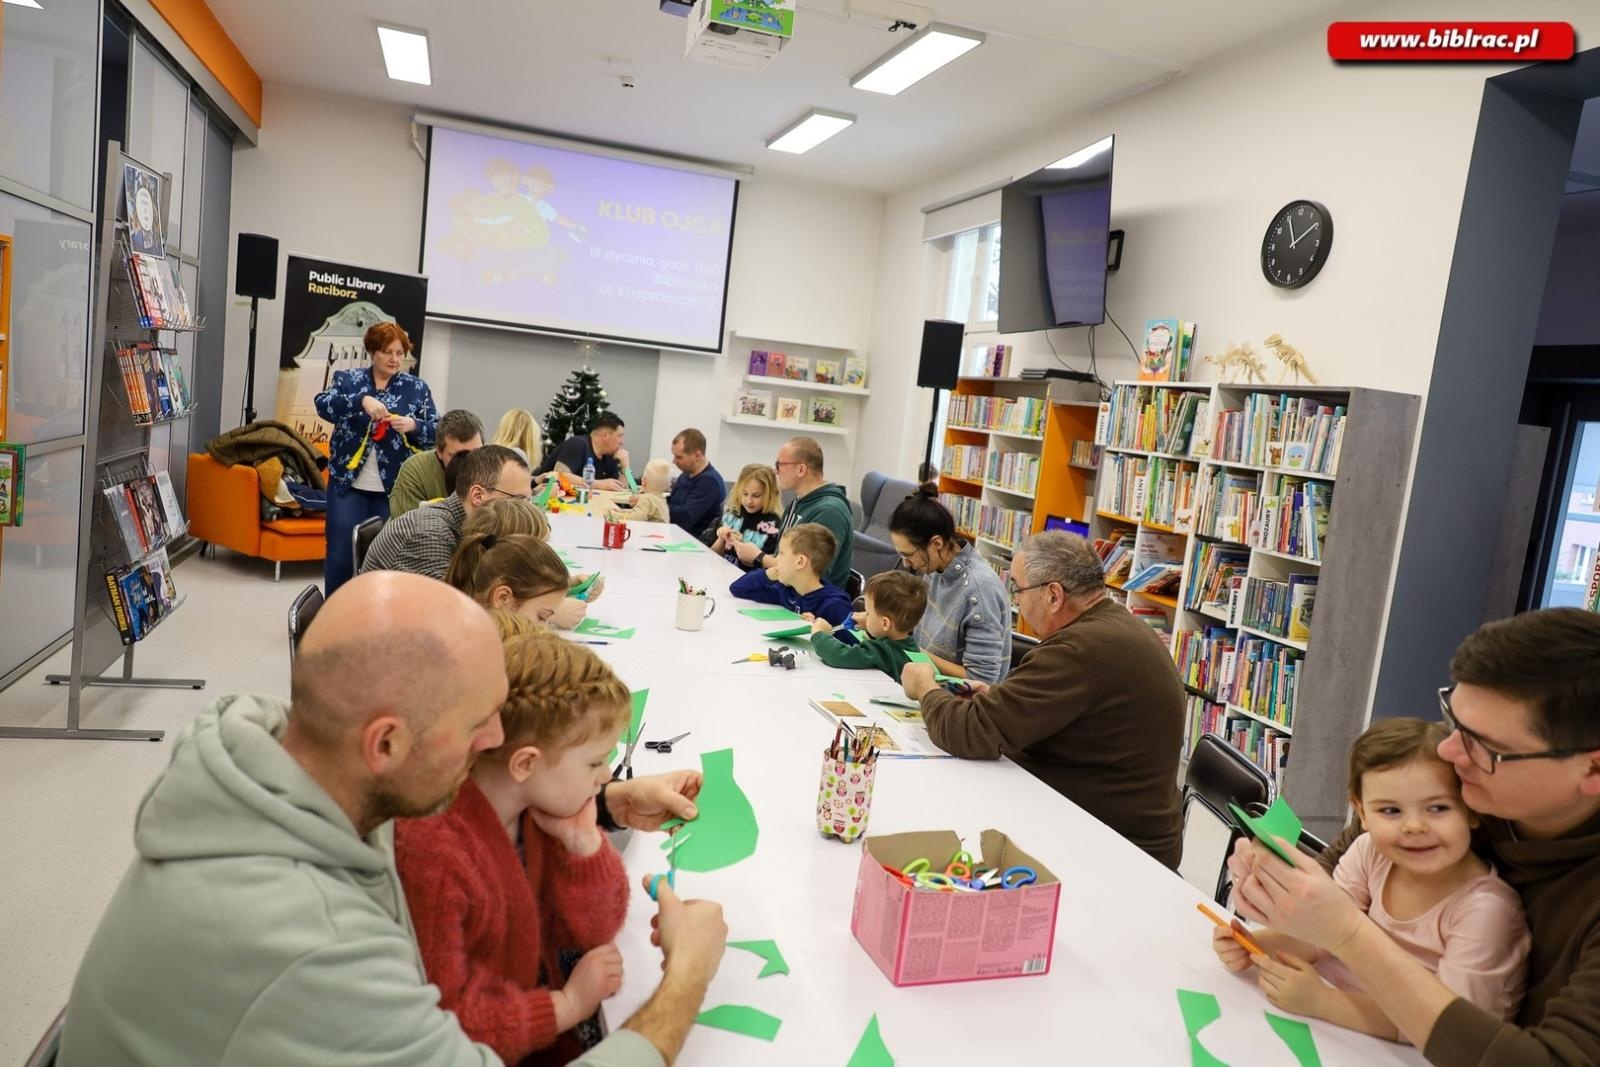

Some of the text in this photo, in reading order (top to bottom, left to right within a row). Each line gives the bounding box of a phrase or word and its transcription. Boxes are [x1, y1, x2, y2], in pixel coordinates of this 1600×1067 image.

[597, 200, 723, 237] KLUB OJCA
[589, 246, 602, 260] 13
[308, 270, 385, 294] Public Library
[654, 272, 719, 292] Biblioteka
[1299, 268, 1304, 276] 5
[308, 282, 358, 300] Raciborz
[617, 284, 701, 306] Kasprowicza
[1261, 510, 1271, 549] DINOZAURY
[106, 575, 120, 606] BATMAN
